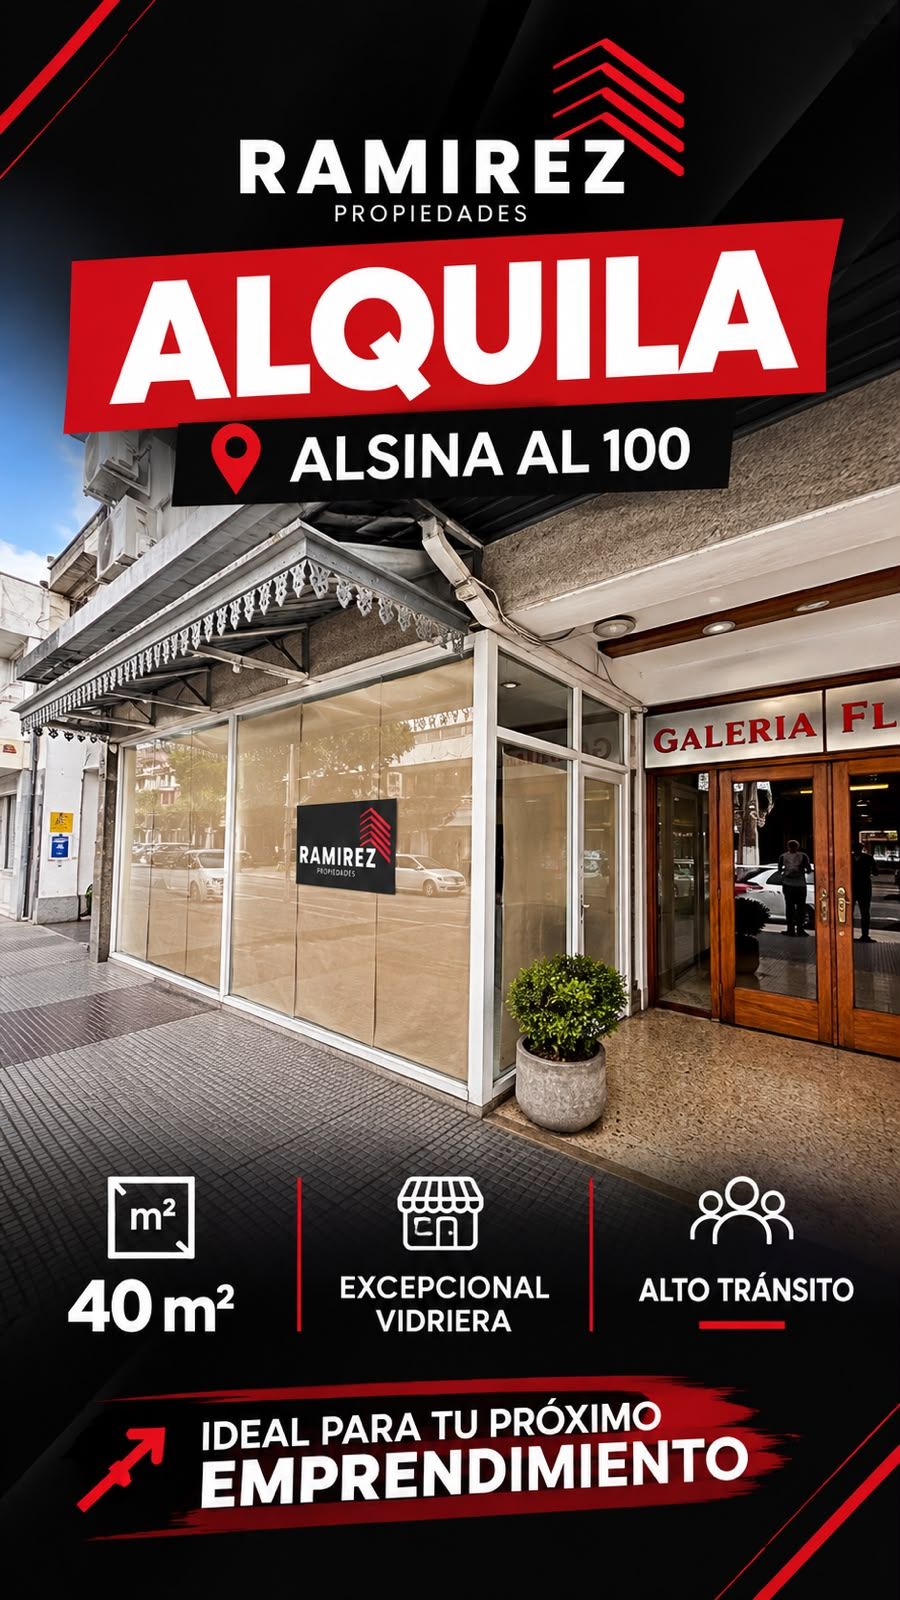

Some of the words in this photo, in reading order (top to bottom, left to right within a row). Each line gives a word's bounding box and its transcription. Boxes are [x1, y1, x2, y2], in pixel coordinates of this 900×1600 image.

[653, 712, 817, 753] GALERIA
[841, 700, 897, 733] FL
[299, 845, 377, 869] RAMIREZ
[316, 867, 356, 878] PROPIEDADES
